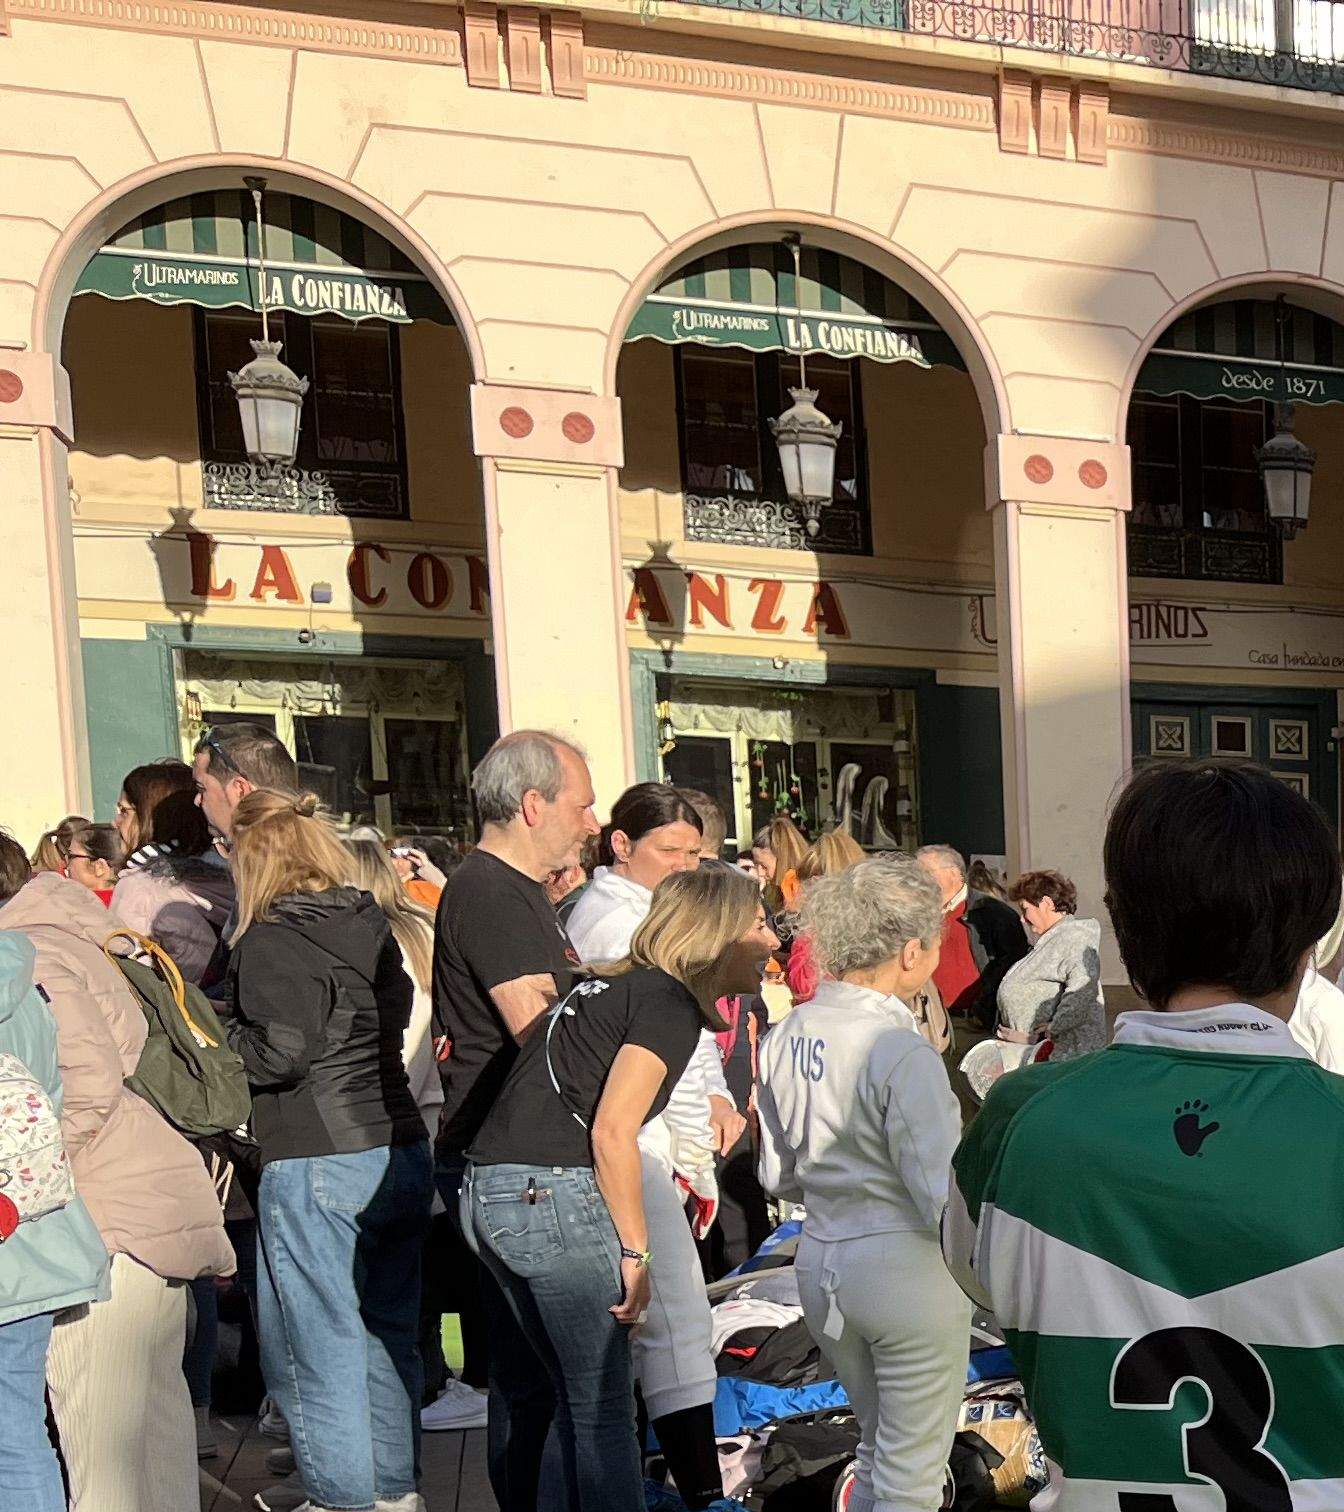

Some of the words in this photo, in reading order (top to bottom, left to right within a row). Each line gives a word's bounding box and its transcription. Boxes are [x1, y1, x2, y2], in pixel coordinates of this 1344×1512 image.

[144, 263, 239, 288] ULTRAMARINOS
[291, 274, 408, 317] CONFIANZA
[681, 309, 770, 331] ULTRAMARINOS
[786, 318, 813, 349] LA
[817, 321, 923, 360] CONFIANZA
[1221, 367, 1274, 391] desde
[1286, 377, 1326, 398] 1871
[187, 532, 303, 605] LA
[1248, 648, 1279, 665] Casa
